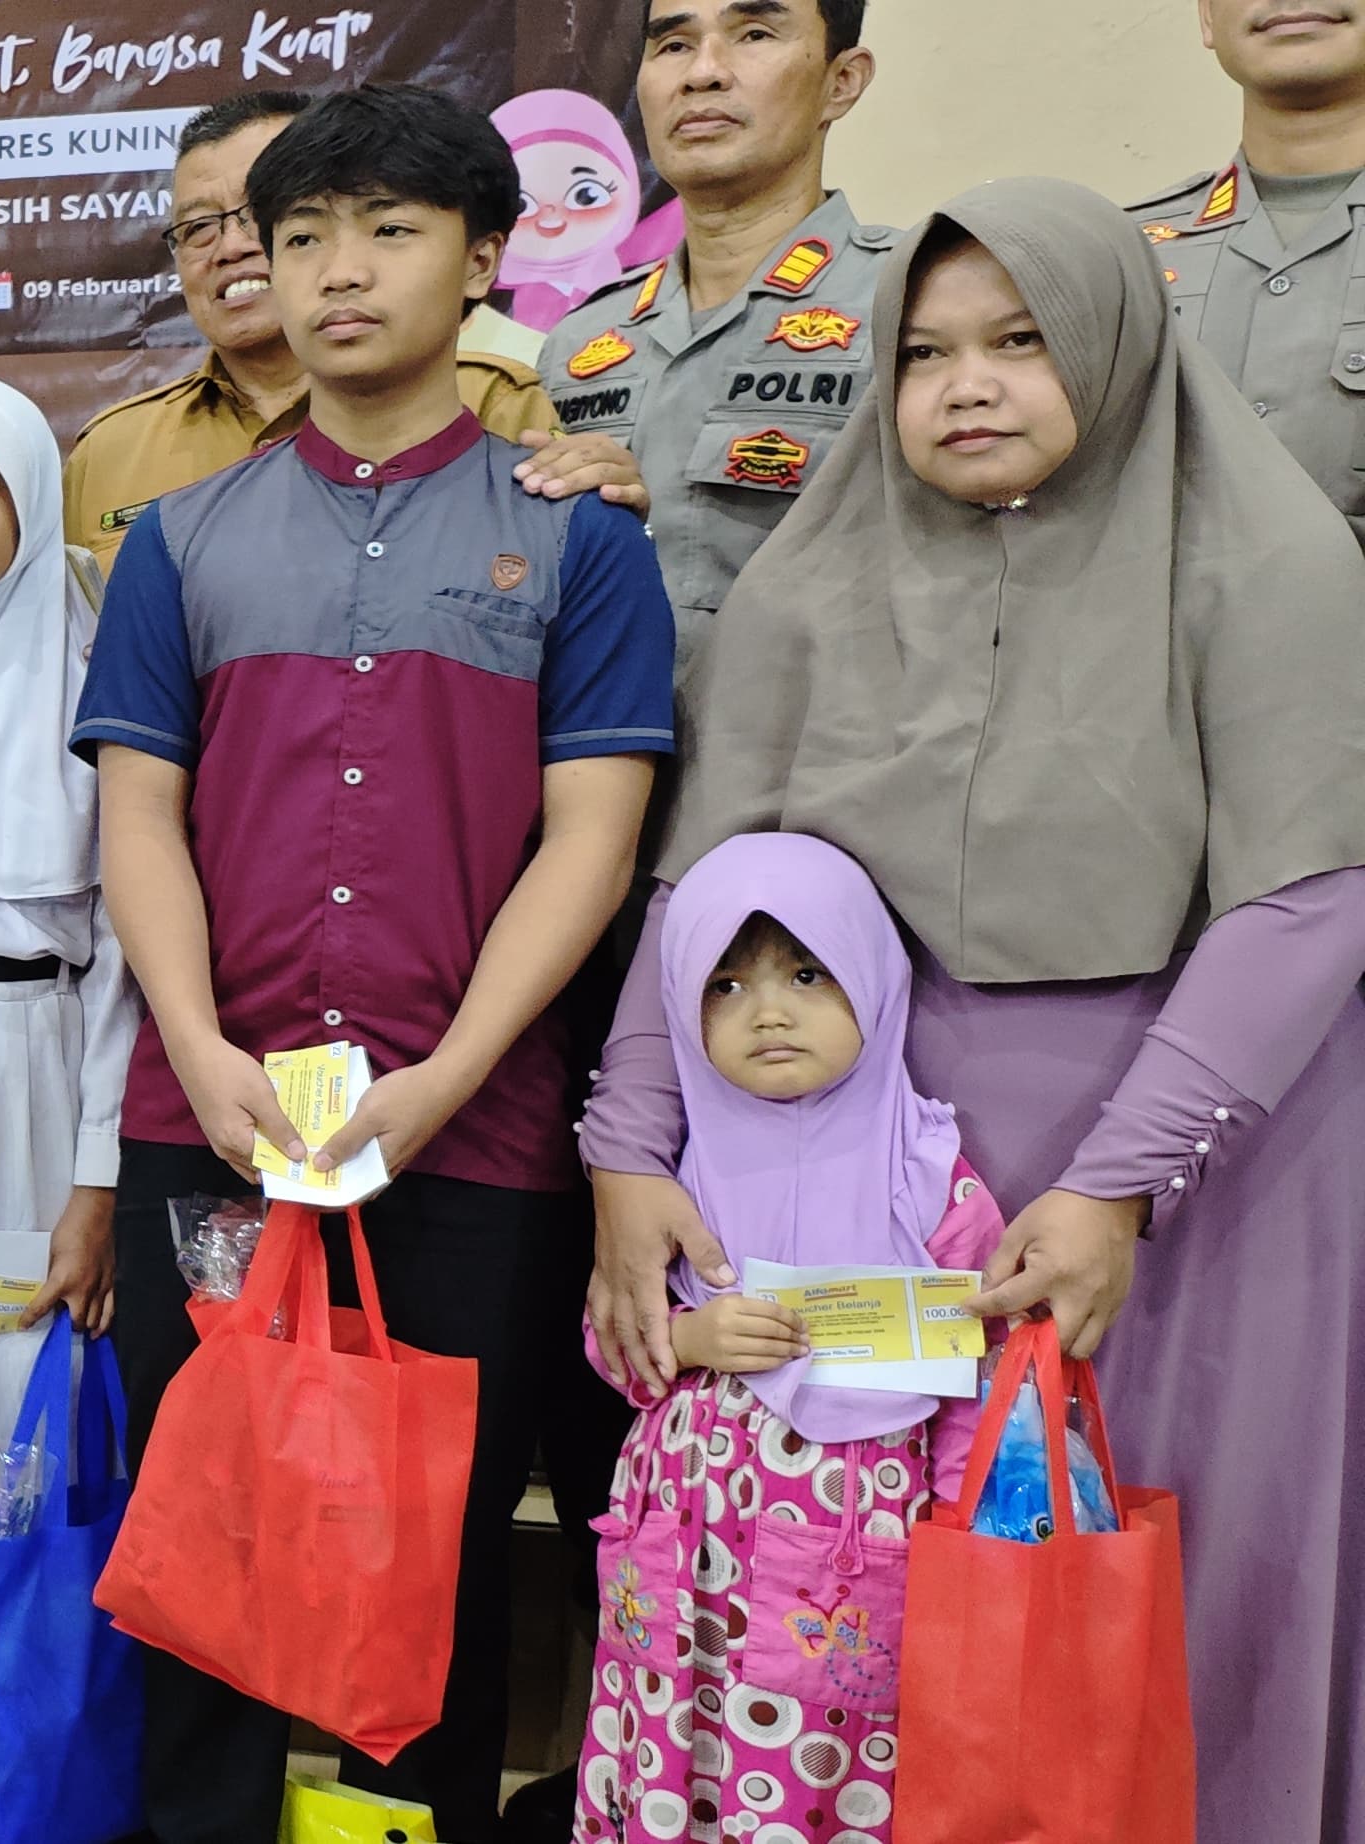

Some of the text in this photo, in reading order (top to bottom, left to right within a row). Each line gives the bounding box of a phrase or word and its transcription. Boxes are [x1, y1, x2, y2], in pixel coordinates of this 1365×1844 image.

[53, 24, 223, 94] Bangsa
[68, 125, 177, 155] KUNIN
[60, 189, 173, 221] SAYAN
[23, 280, 52, 298] 09
[58, 274, 161, 296] Februari
[728, 372, 853, 405] POLRI
[791, 1301, 833, 1313] oucher
[925, 1307, 965, 1319] 100.00
